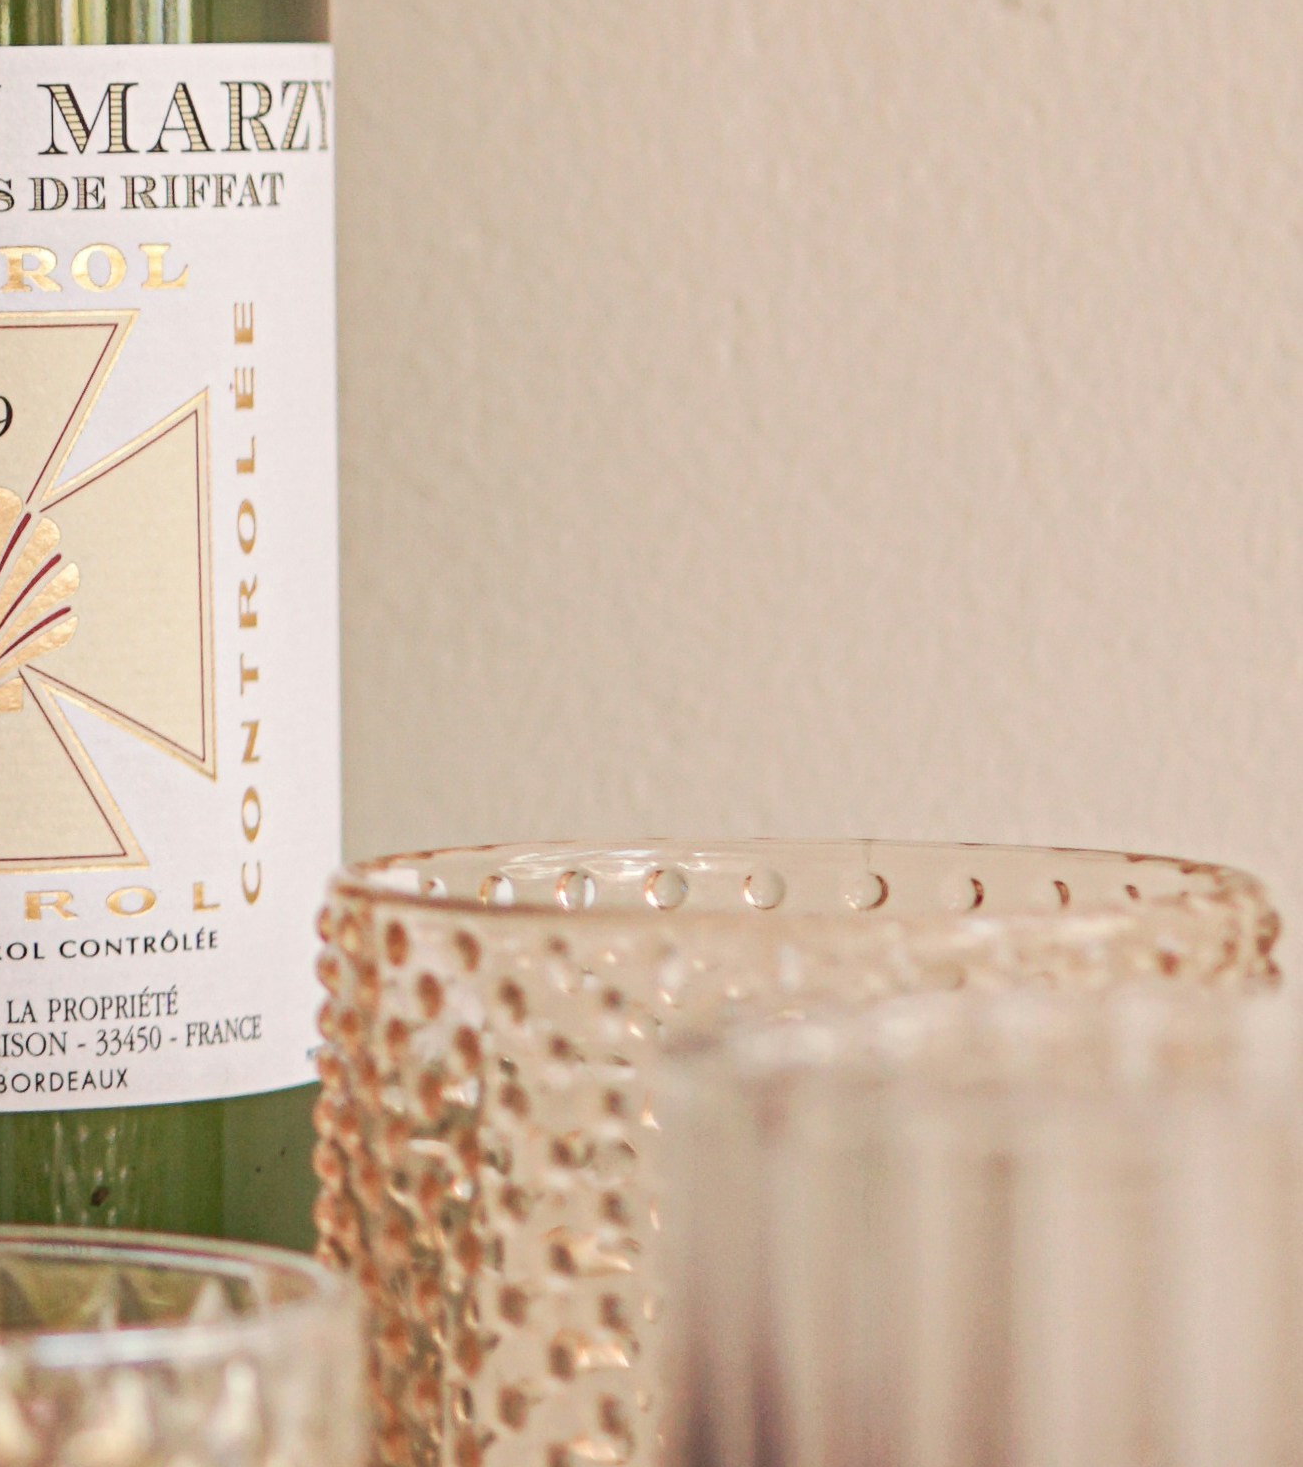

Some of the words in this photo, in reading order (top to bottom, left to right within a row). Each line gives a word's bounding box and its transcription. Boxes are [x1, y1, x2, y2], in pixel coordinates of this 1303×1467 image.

[28, 174, 106, 211] DE
[120, 172, 285, 209] RIFFAT
[59, 926, 219, 959] CONTRÔLÉE
[6, 998, 38, 1024] LA
[48, 984, 179, 1023] PROPRIÉTÉ
[95, 1026, 162, 1056] 33450
[186, 1014, 262, 1047] FRANCE
